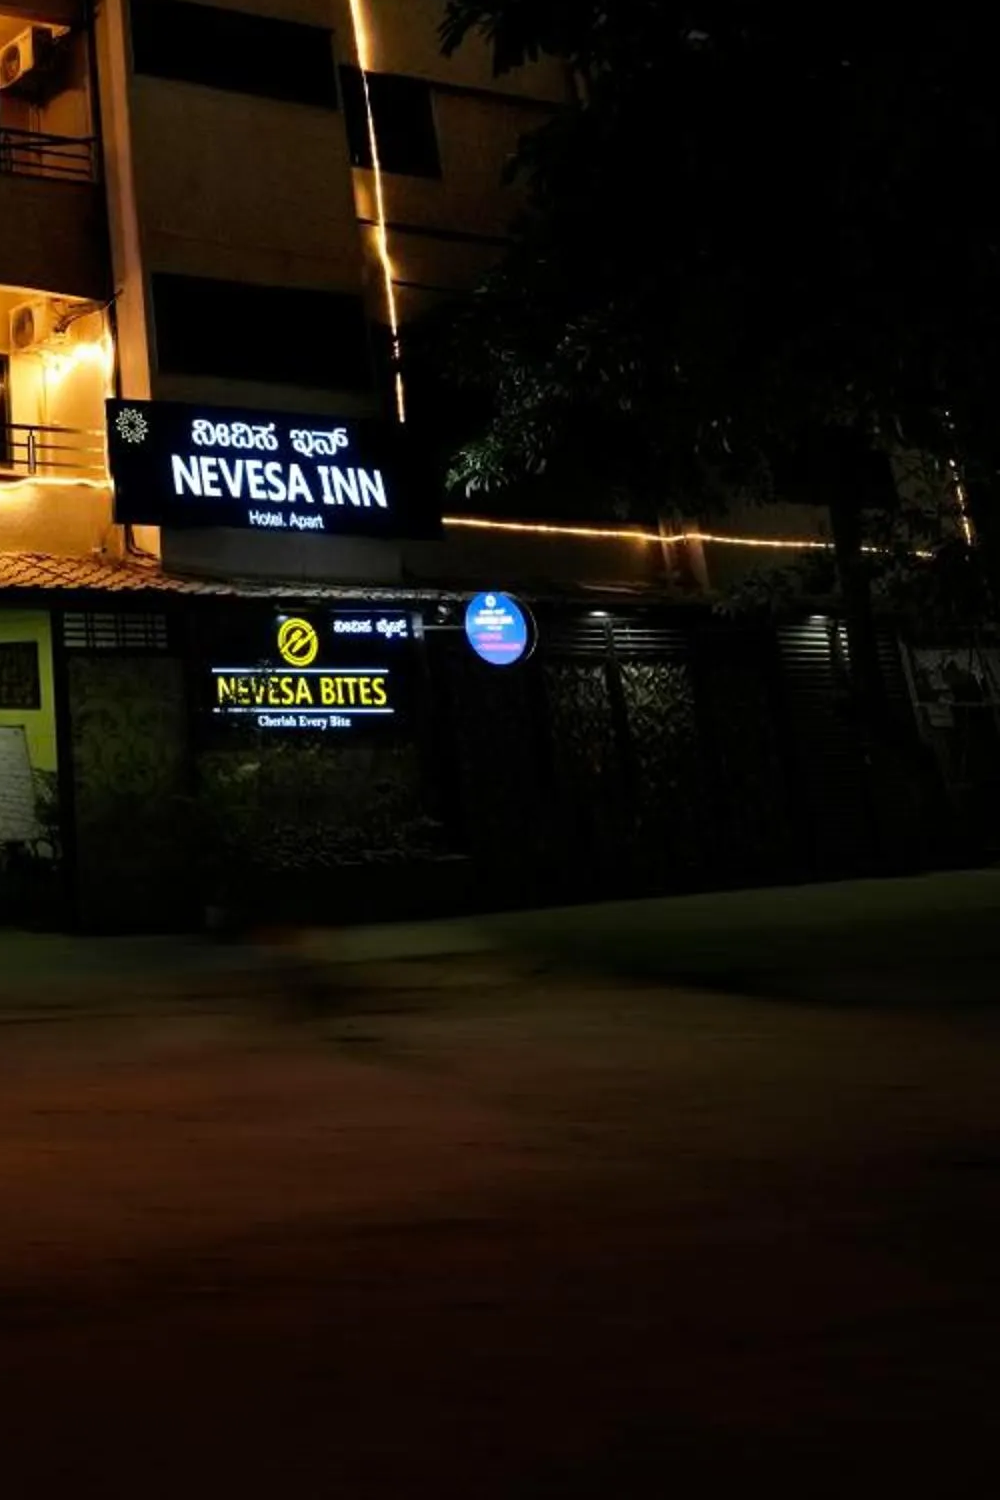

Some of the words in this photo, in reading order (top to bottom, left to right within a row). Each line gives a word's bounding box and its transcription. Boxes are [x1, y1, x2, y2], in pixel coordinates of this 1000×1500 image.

[171, 453, 314, 503] NEVESA
[318, 465, 388, 508] INN
[289, 511, 324, 530] Apart
[217, 676, 313, 705] NEVESA
[320, 677, 387, 705] BITES
[257, 715, 297, 727] Cherish
[298, 715, 327, 731] Every
[329, 715, 352, 727] Bite
